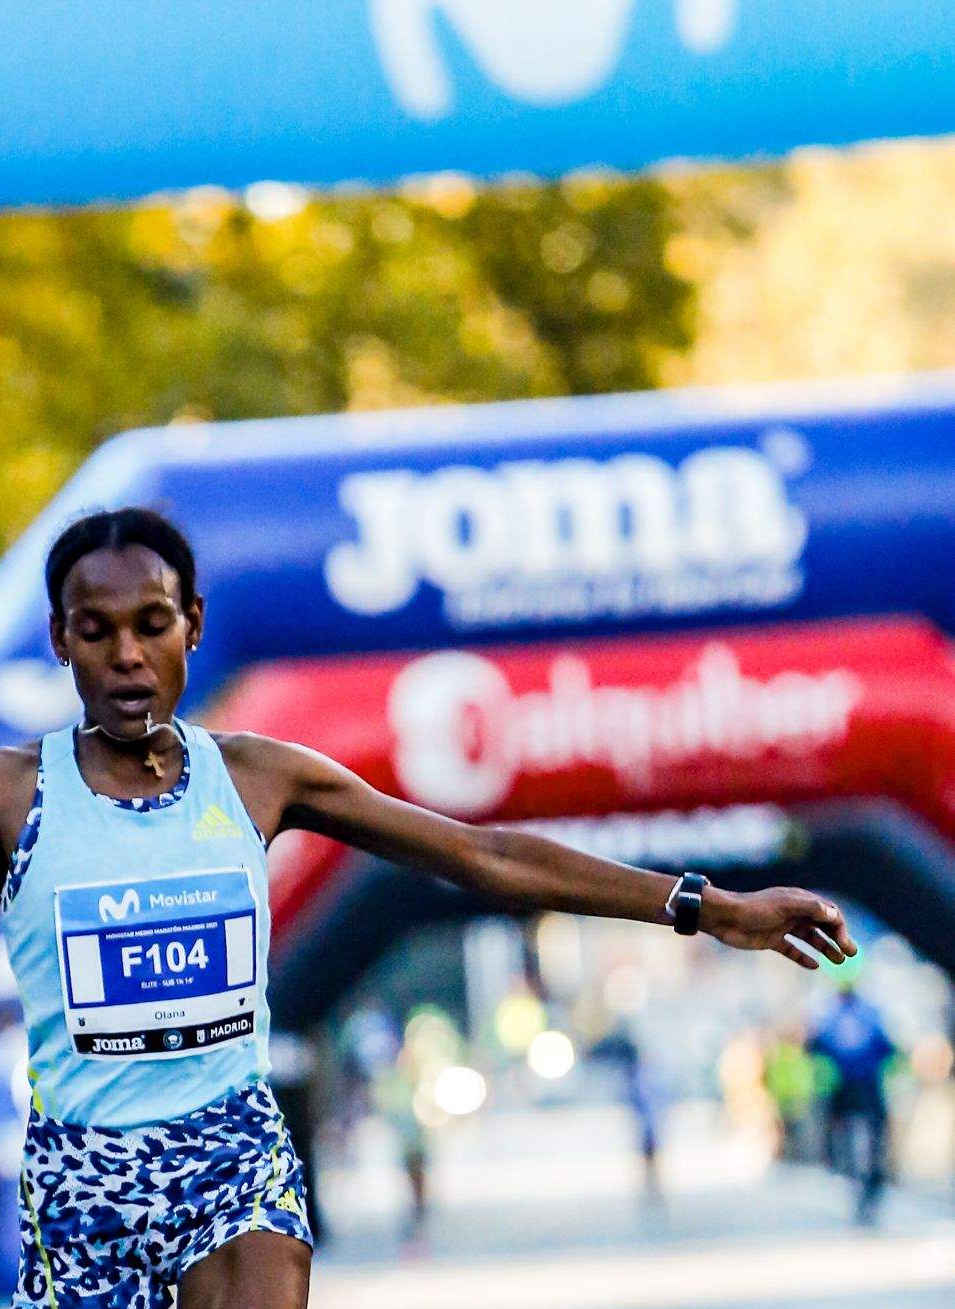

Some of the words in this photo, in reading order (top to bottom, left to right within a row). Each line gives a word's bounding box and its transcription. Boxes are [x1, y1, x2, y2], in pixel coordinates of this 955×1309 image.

[149, 889, 218, 909] Movistar
[121, 938, 210, 978] F104
[154, 1010, 186, 1021] Olana
[210, 1019, 249, 1039] MADRID
